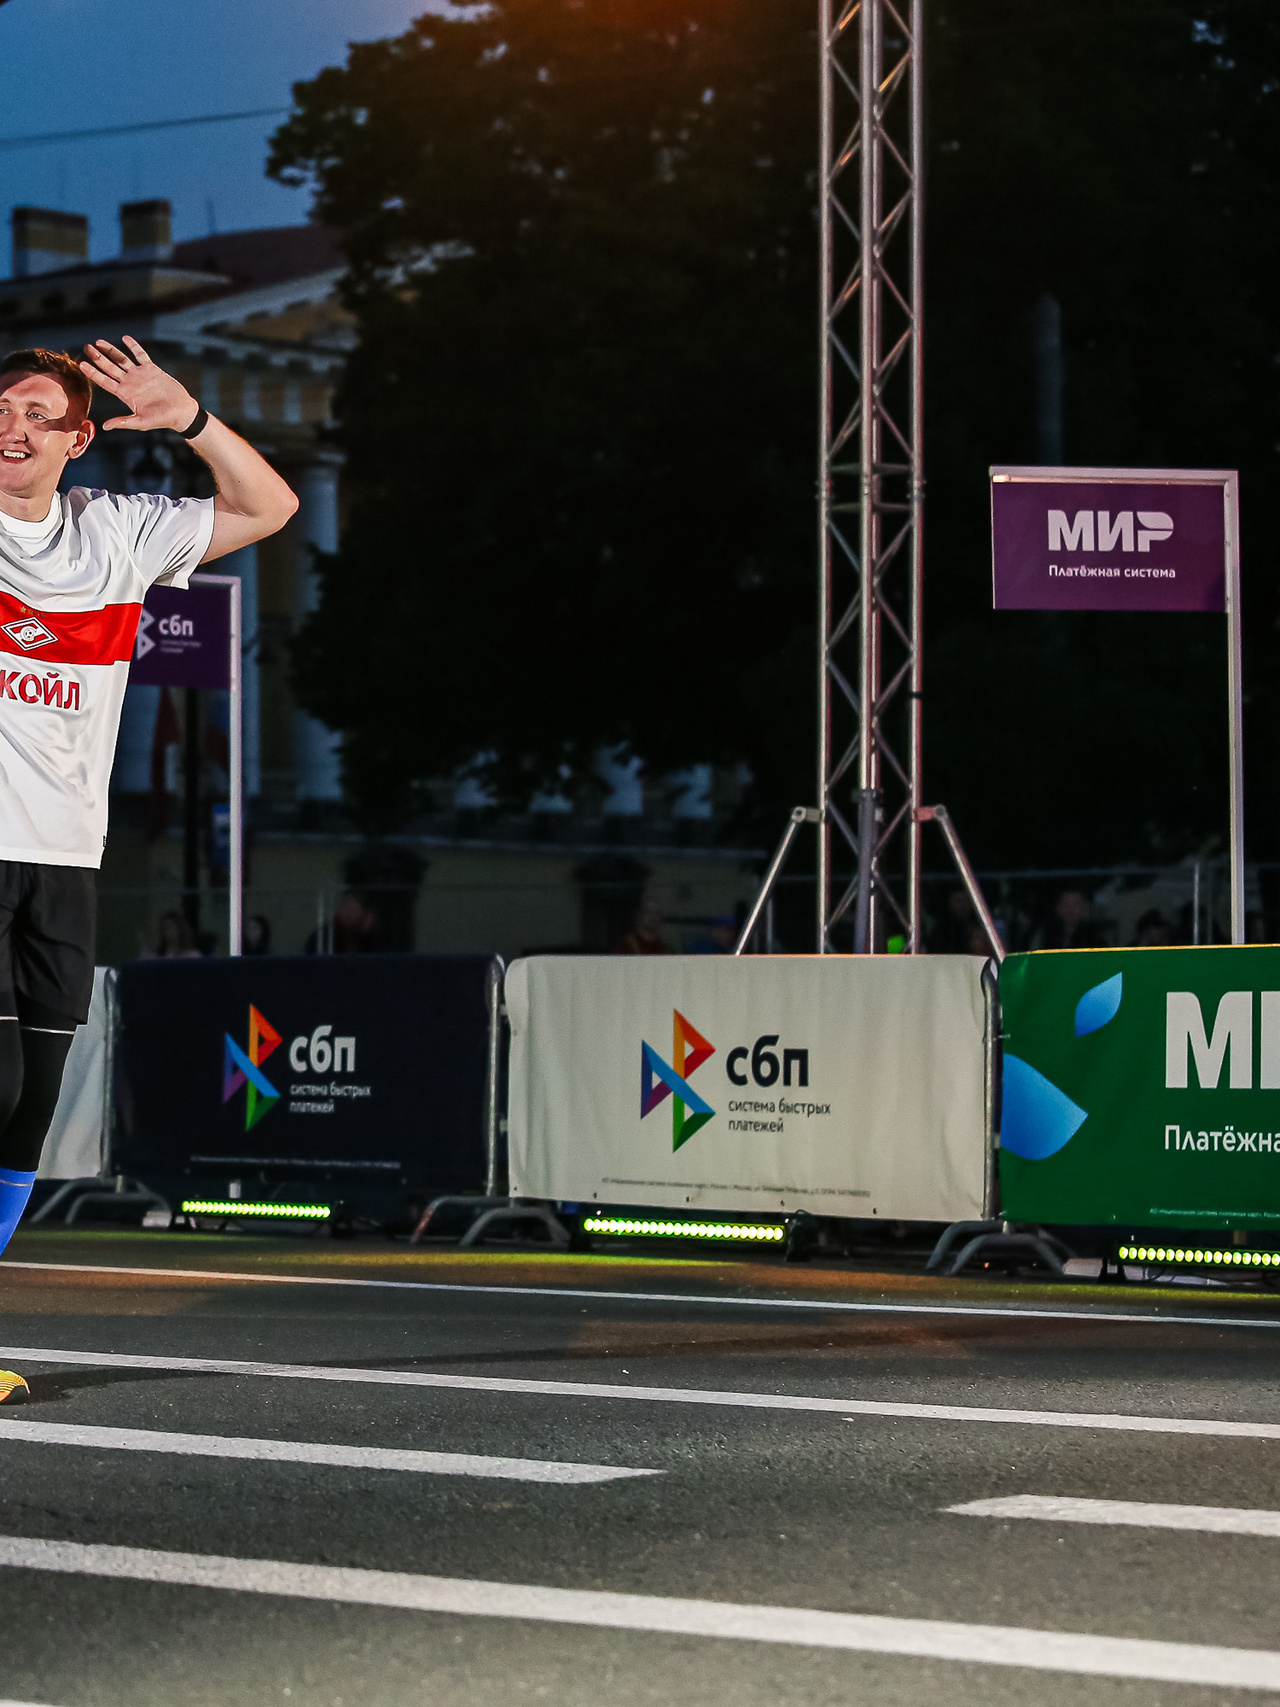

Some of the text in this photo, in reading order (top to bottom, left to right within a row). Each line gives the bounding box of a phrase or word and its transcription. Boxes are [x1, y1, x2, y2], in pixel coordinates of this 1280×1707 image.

[1047, 509, 1174, 552] МИР
[1049, 564, 1176, 578] Платёжная система
[159, 614, 193, 636] сбп
[289, 1024, 355, 1073] сбп
[726, 1035, 809, 1087] сбп
[290, 1081, 371, 1099] система быстрых
[289, 1099, 335, 1113] платежей
[728, 1097, 831, 1118] система быстрых
[728, 1117, 784, 1132] платежей
